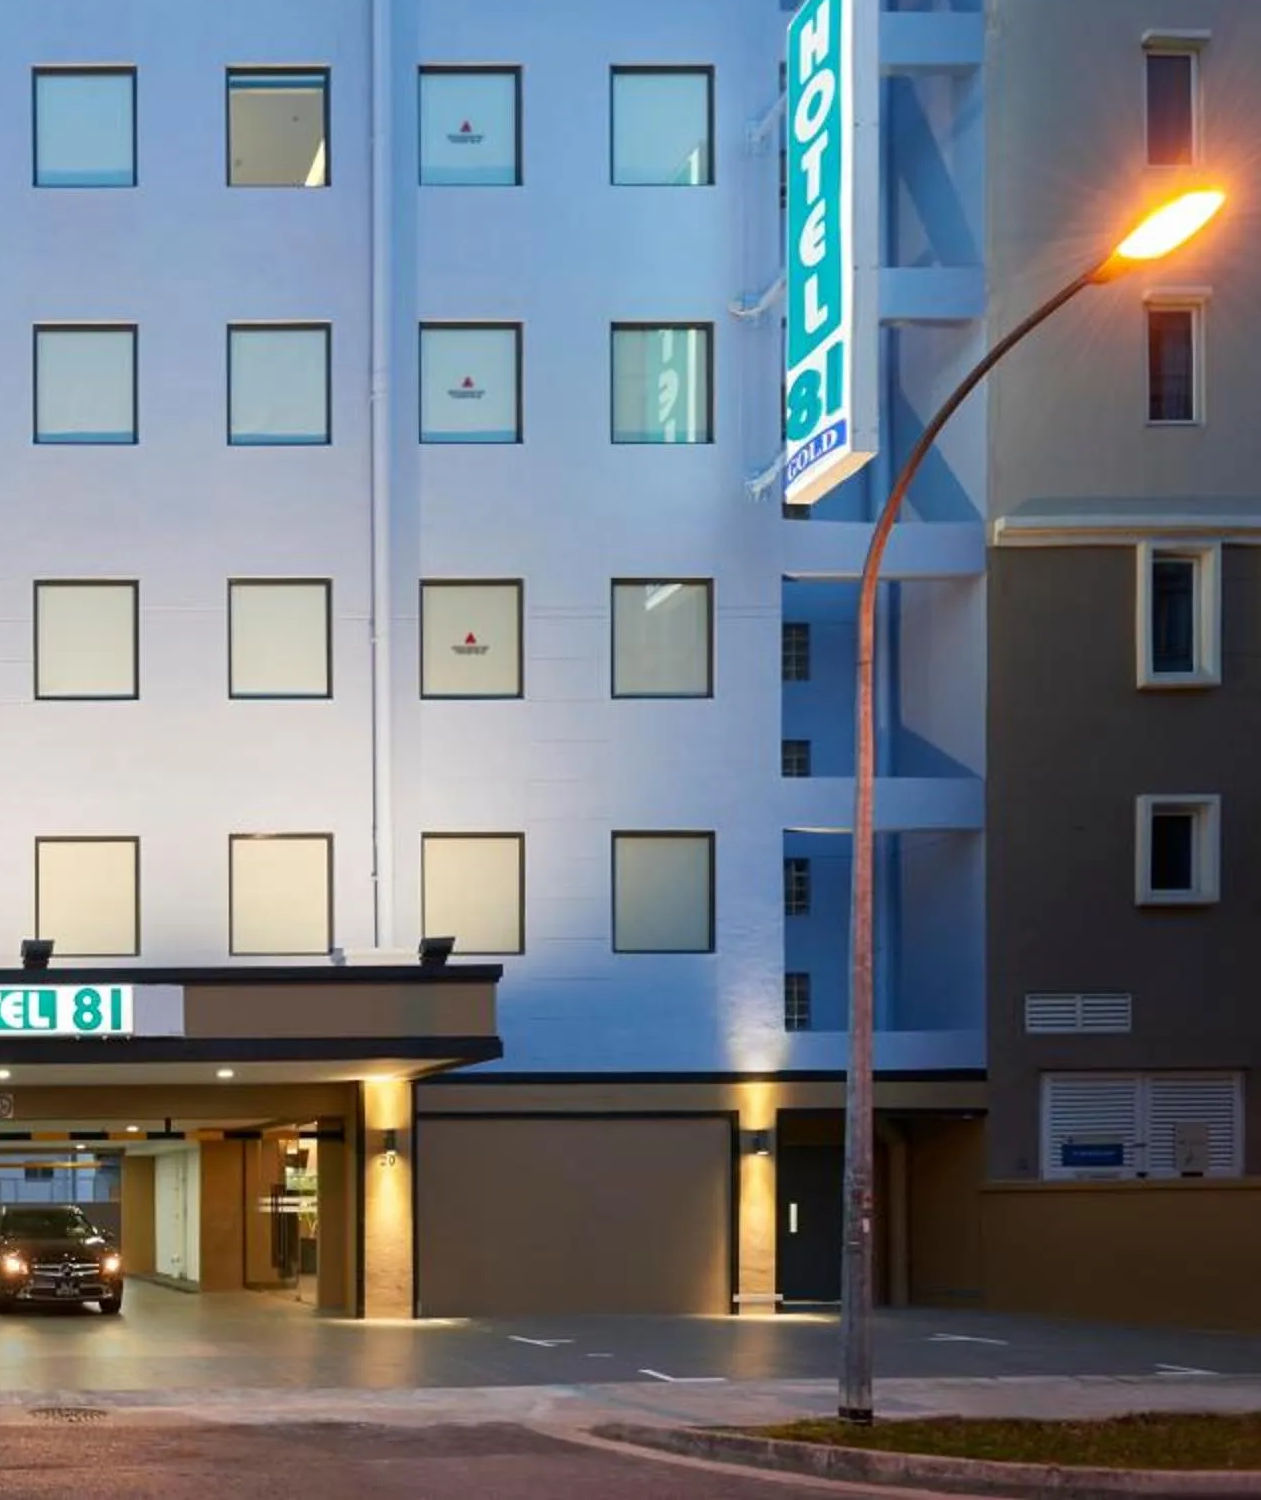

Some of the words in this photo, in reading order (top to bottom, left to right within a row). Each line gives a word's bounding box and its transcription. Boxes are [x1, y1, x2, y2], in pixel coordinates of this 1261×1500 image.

[786, 340, 843, 441] 81
[786, 428, 838, 481] GOLD
[72, 987, 122, 1031] 81
